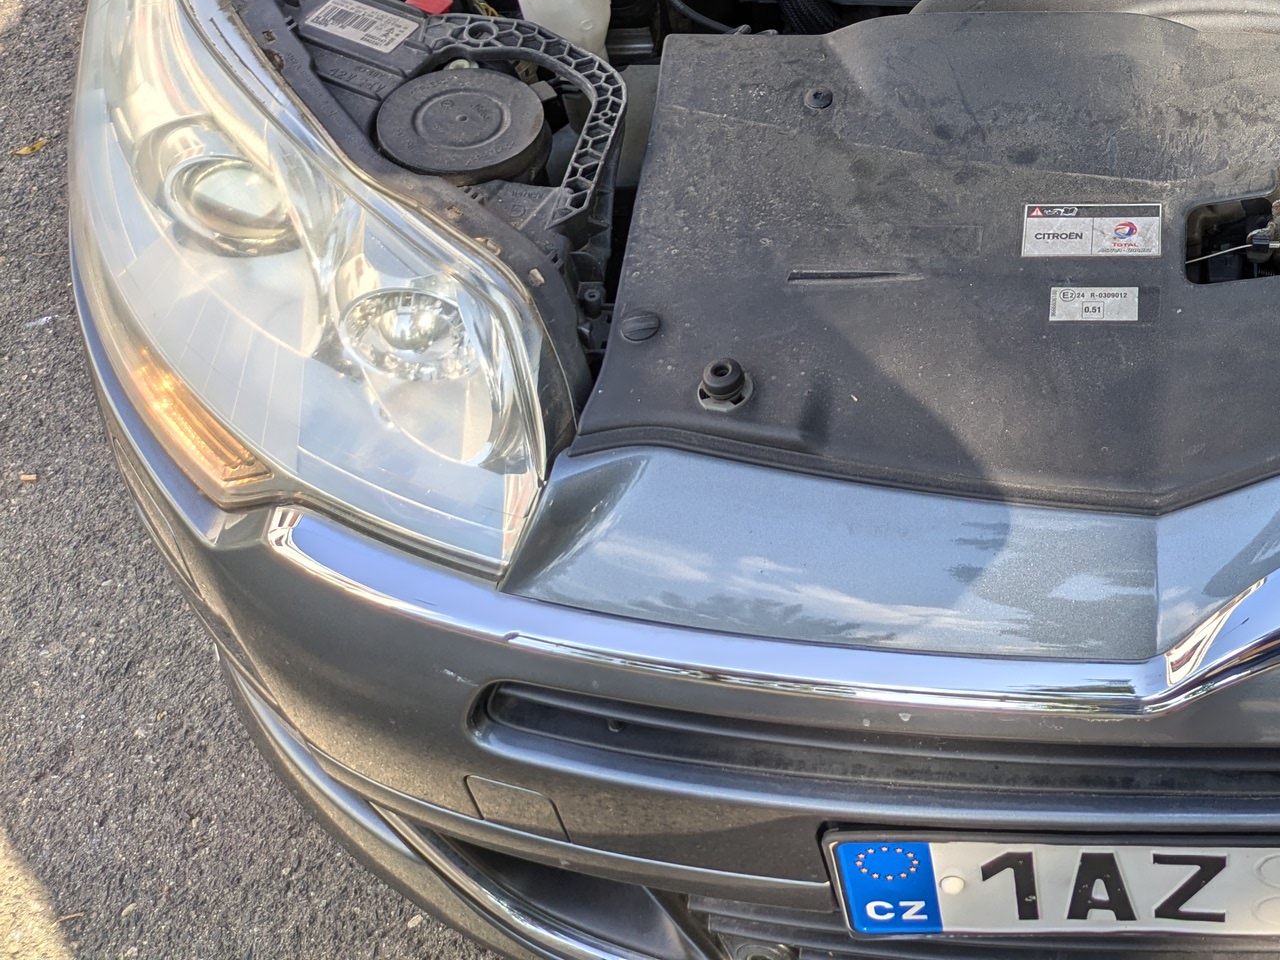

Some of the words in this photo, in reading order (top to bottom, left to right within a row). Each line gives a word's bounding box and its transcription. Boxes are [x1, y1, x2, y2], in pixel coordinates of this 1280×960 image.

[1034, 231, 1083, 240] CITROËN
[1083, 305, 1102, 314] 0.51
[978, 851, 1231, 923] 1AZ
[864, 899, 928, 922] CZ
